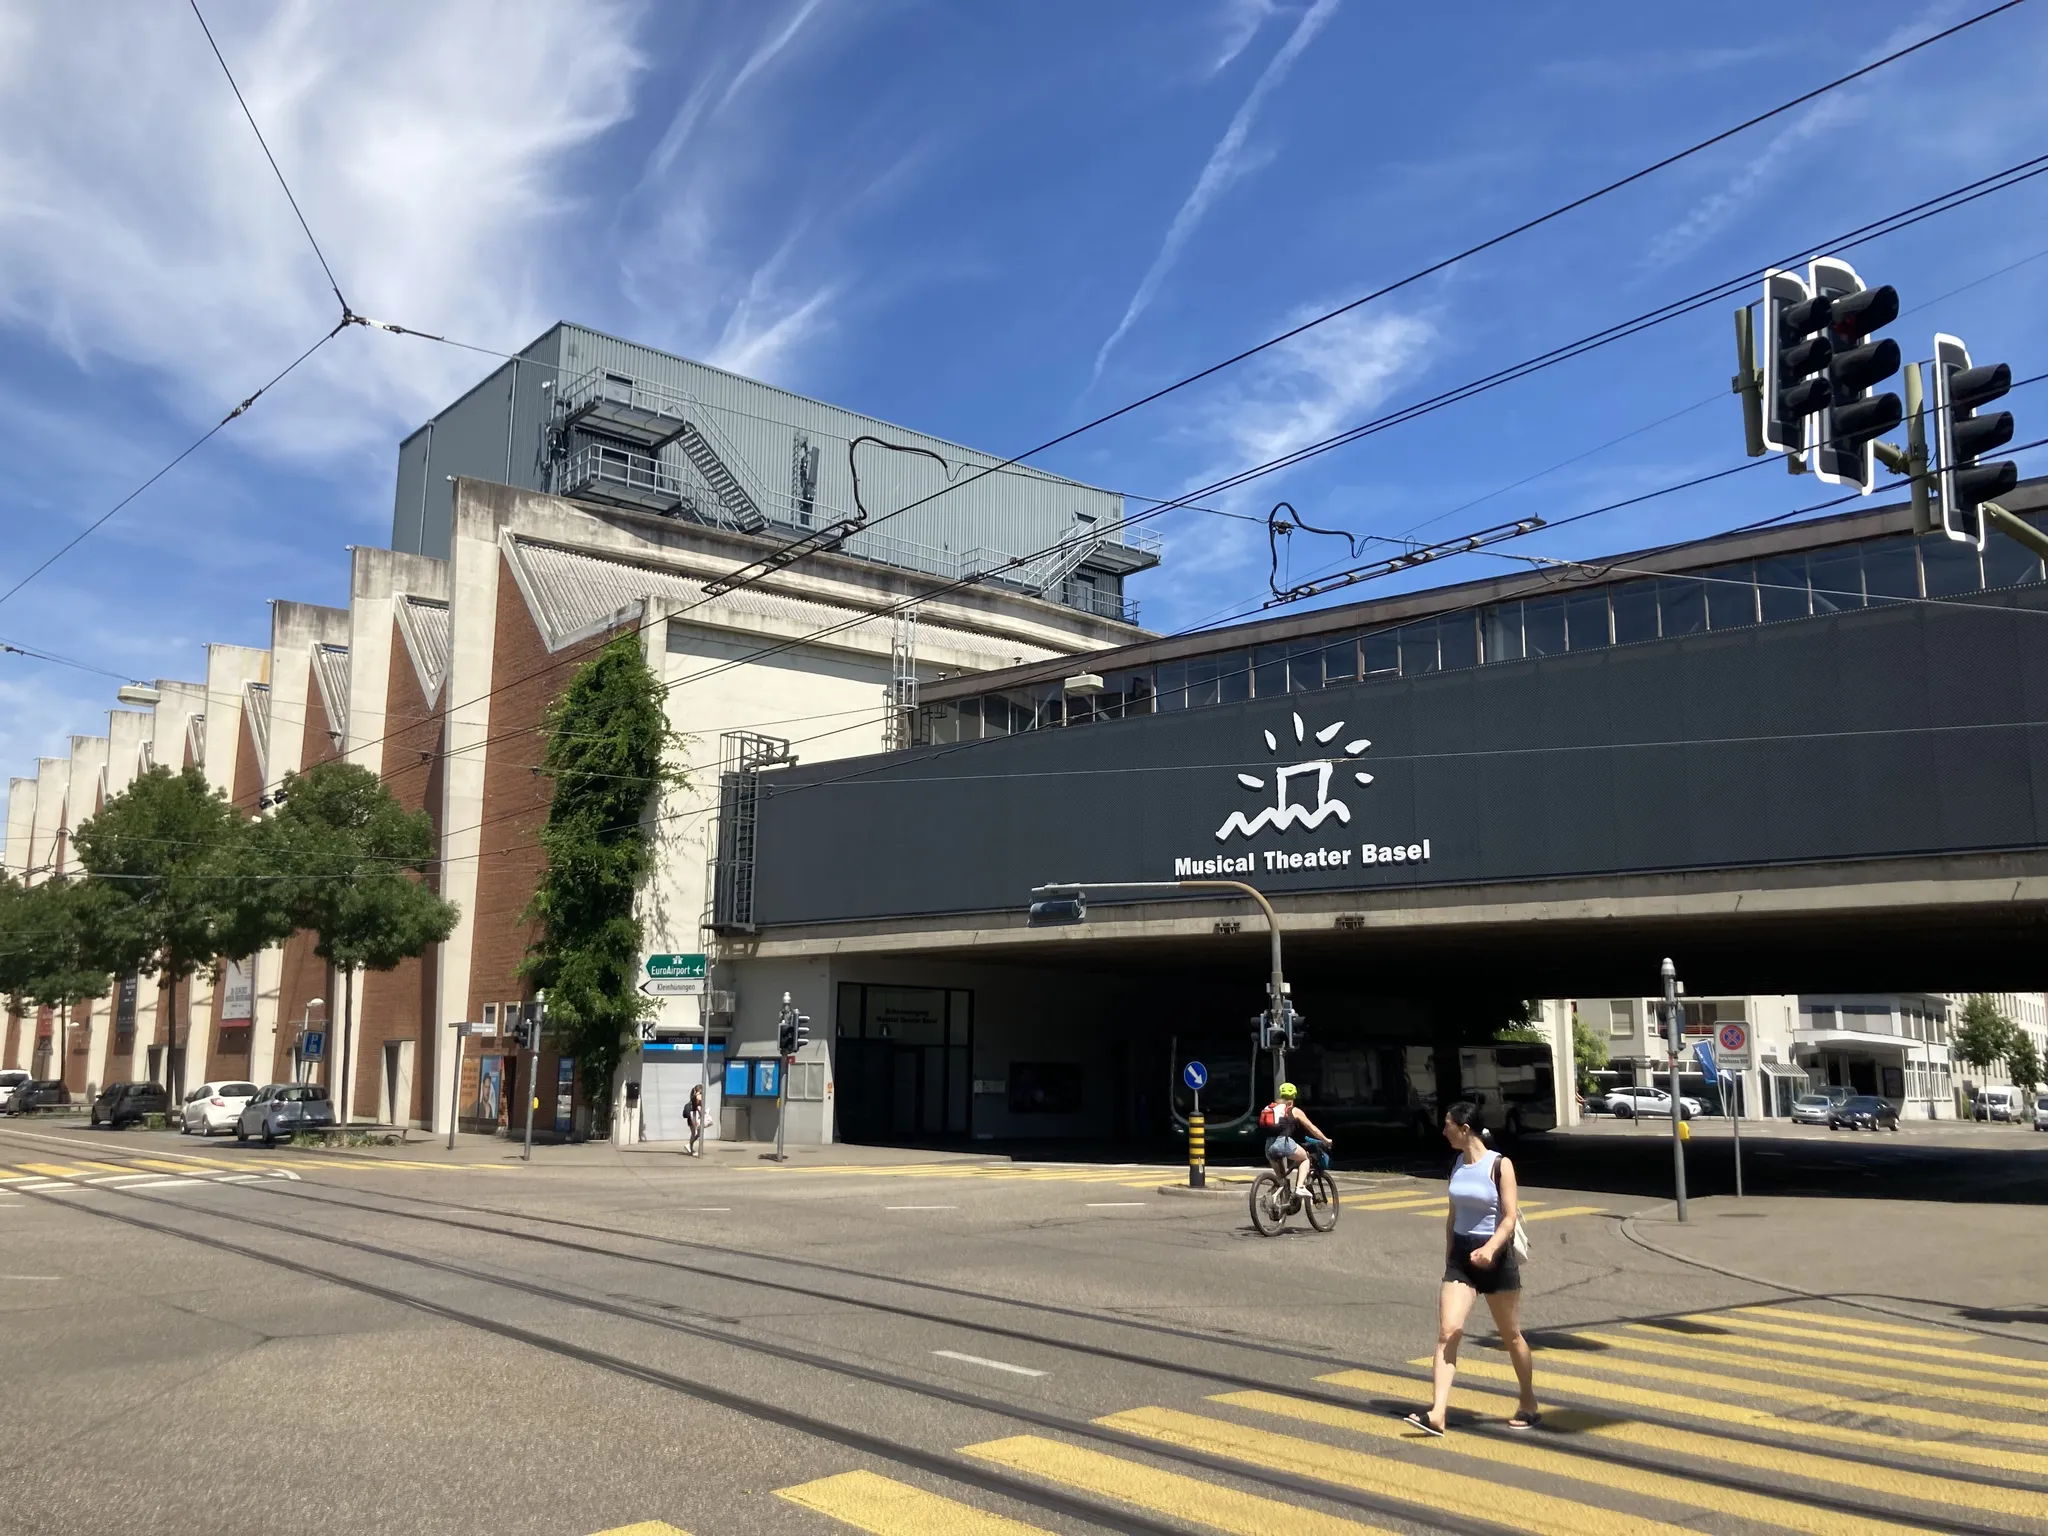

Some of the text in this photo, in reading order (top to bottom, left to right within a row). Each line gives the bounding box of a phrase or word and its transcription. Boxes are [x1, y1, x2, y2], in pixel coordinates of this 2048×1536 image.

[1174, 838, 1431, 876] Musical Theater Basel
[651, 965, 691, 977] EuroAirport
[657, 984, 696, 993] Kleinhüningen
